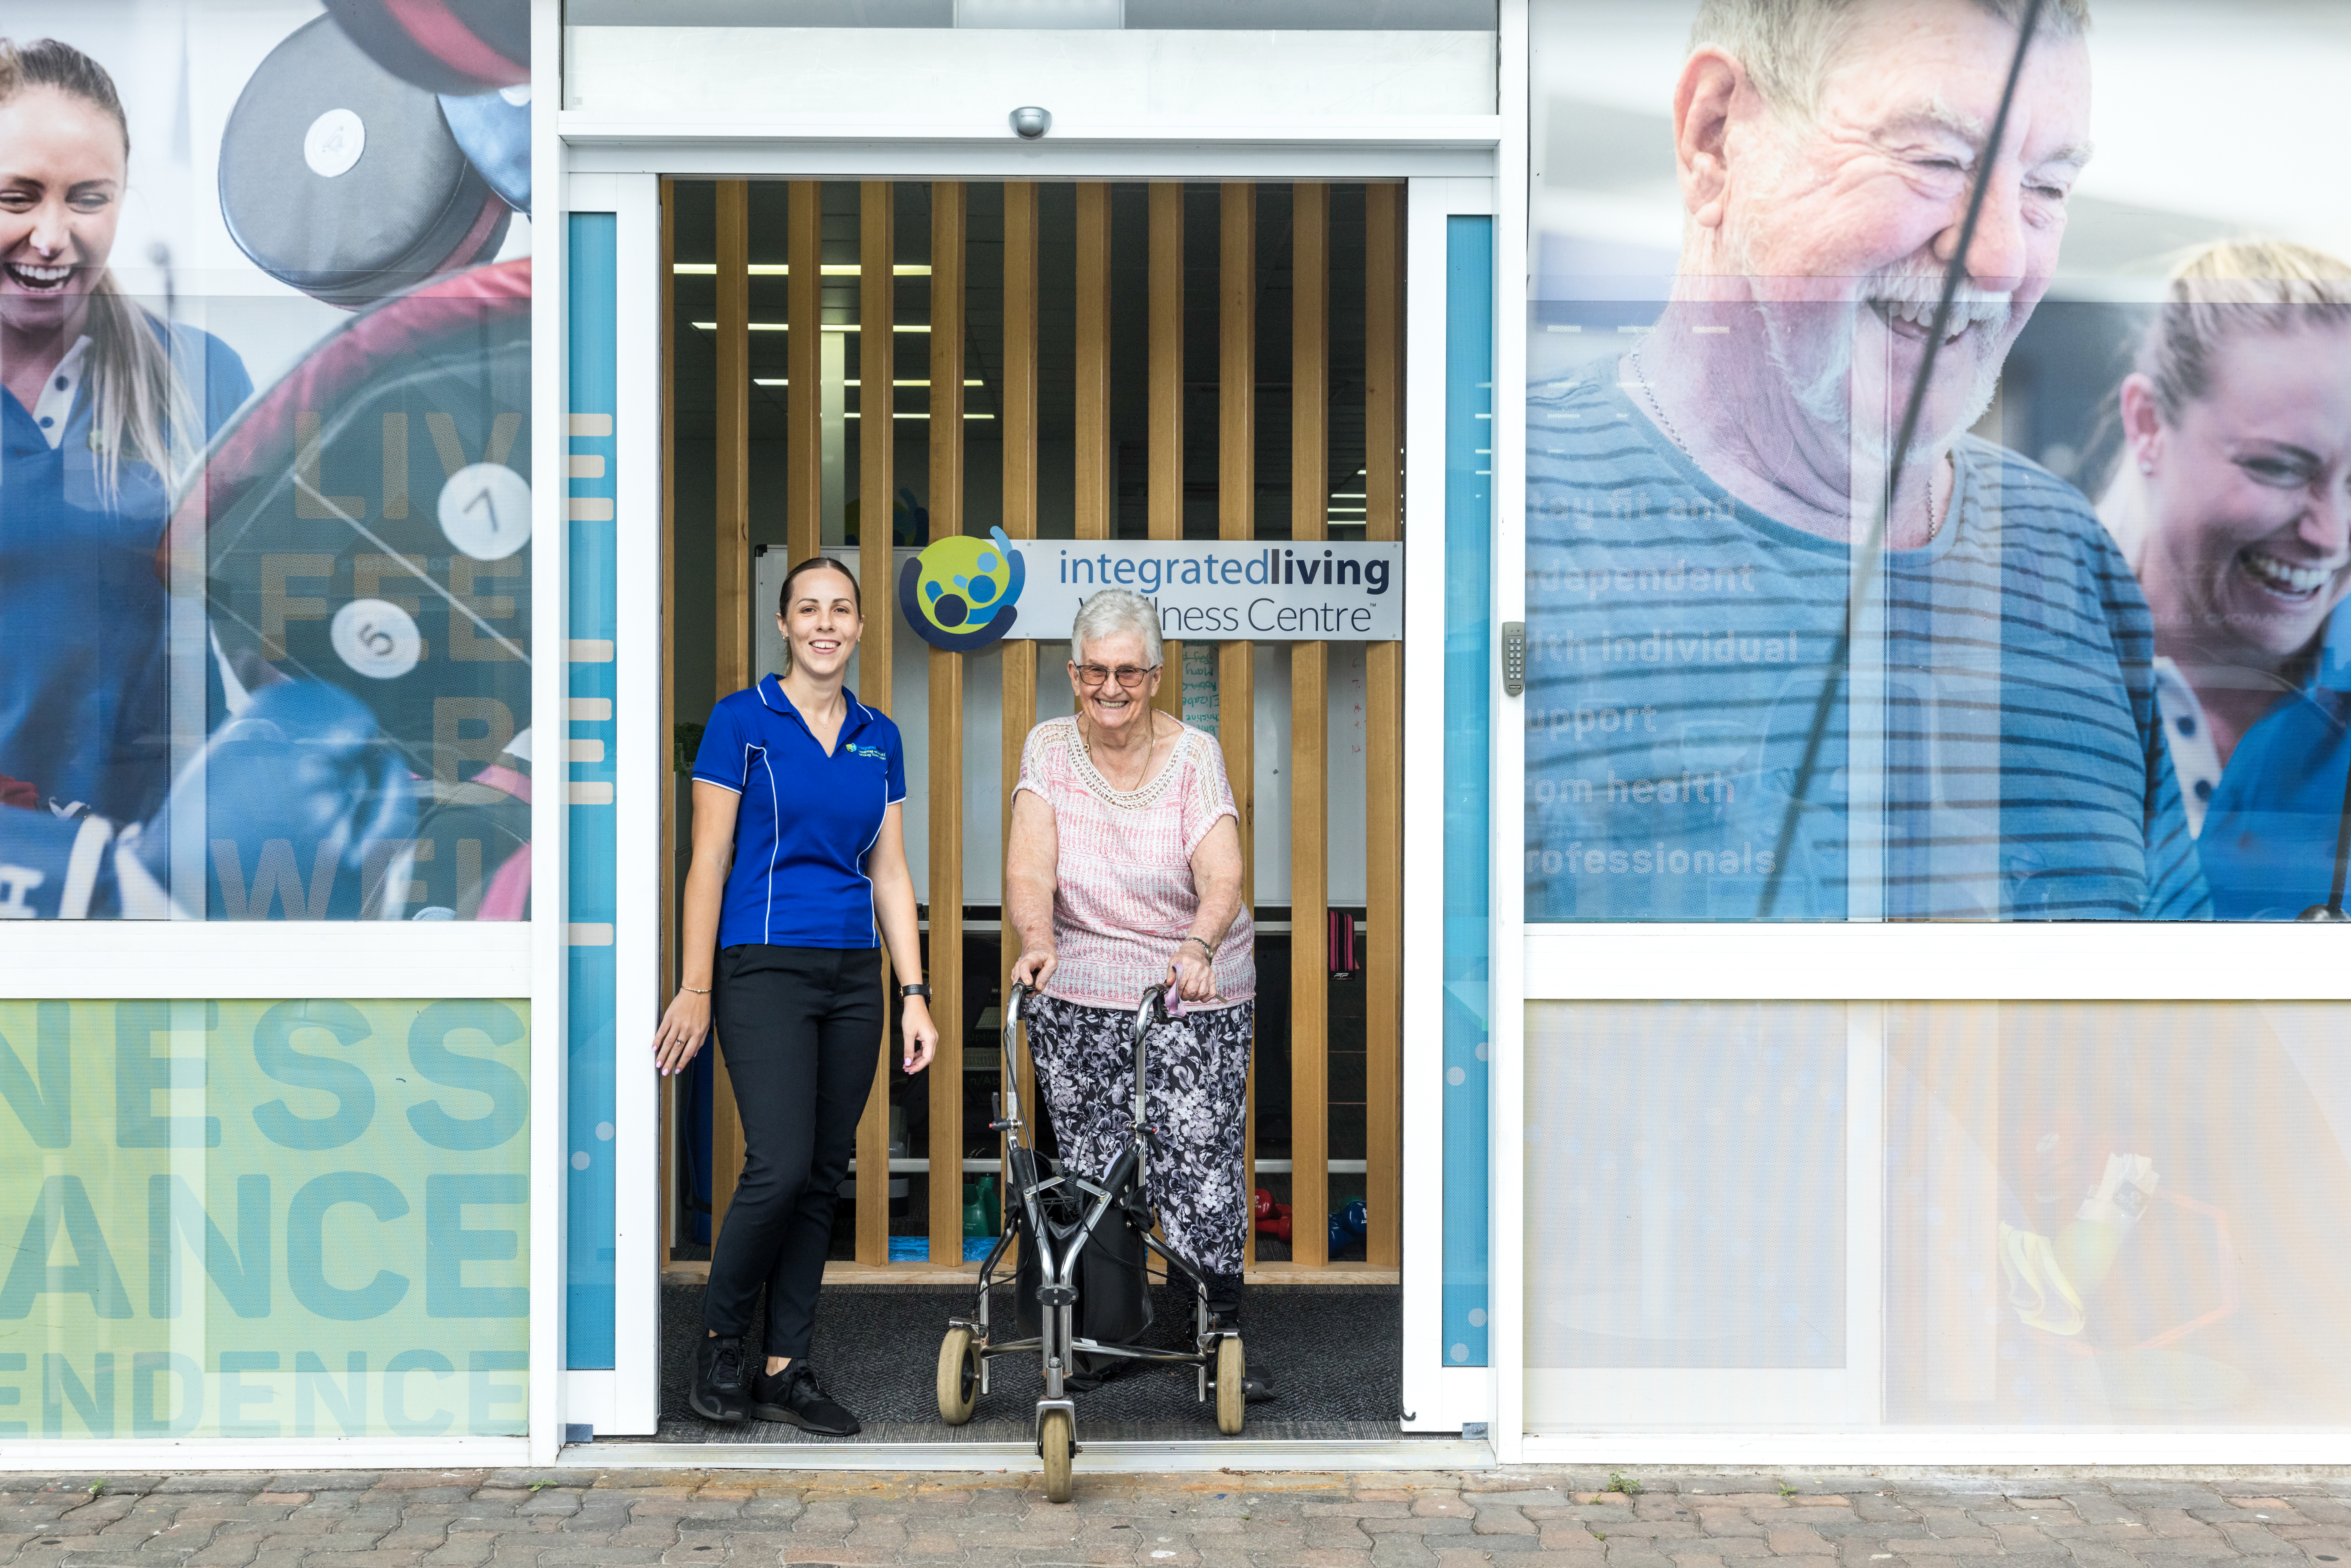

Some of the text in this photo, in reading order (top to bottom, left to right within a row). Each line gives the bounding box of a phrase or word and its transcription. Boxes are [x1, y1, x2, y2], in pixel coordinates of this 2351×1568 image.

[1608, 489, 1652, 521] fit
[1667, 493, 1735, 521] and
[1525, 629, 1798, 663] ith individual
[1186, 663, 1213, 676] Mary
[1185, 713, 1219, 722] hristine
[1608, 770, 1735, 803] health
[0, 1171, 531, 1321] ANCE
